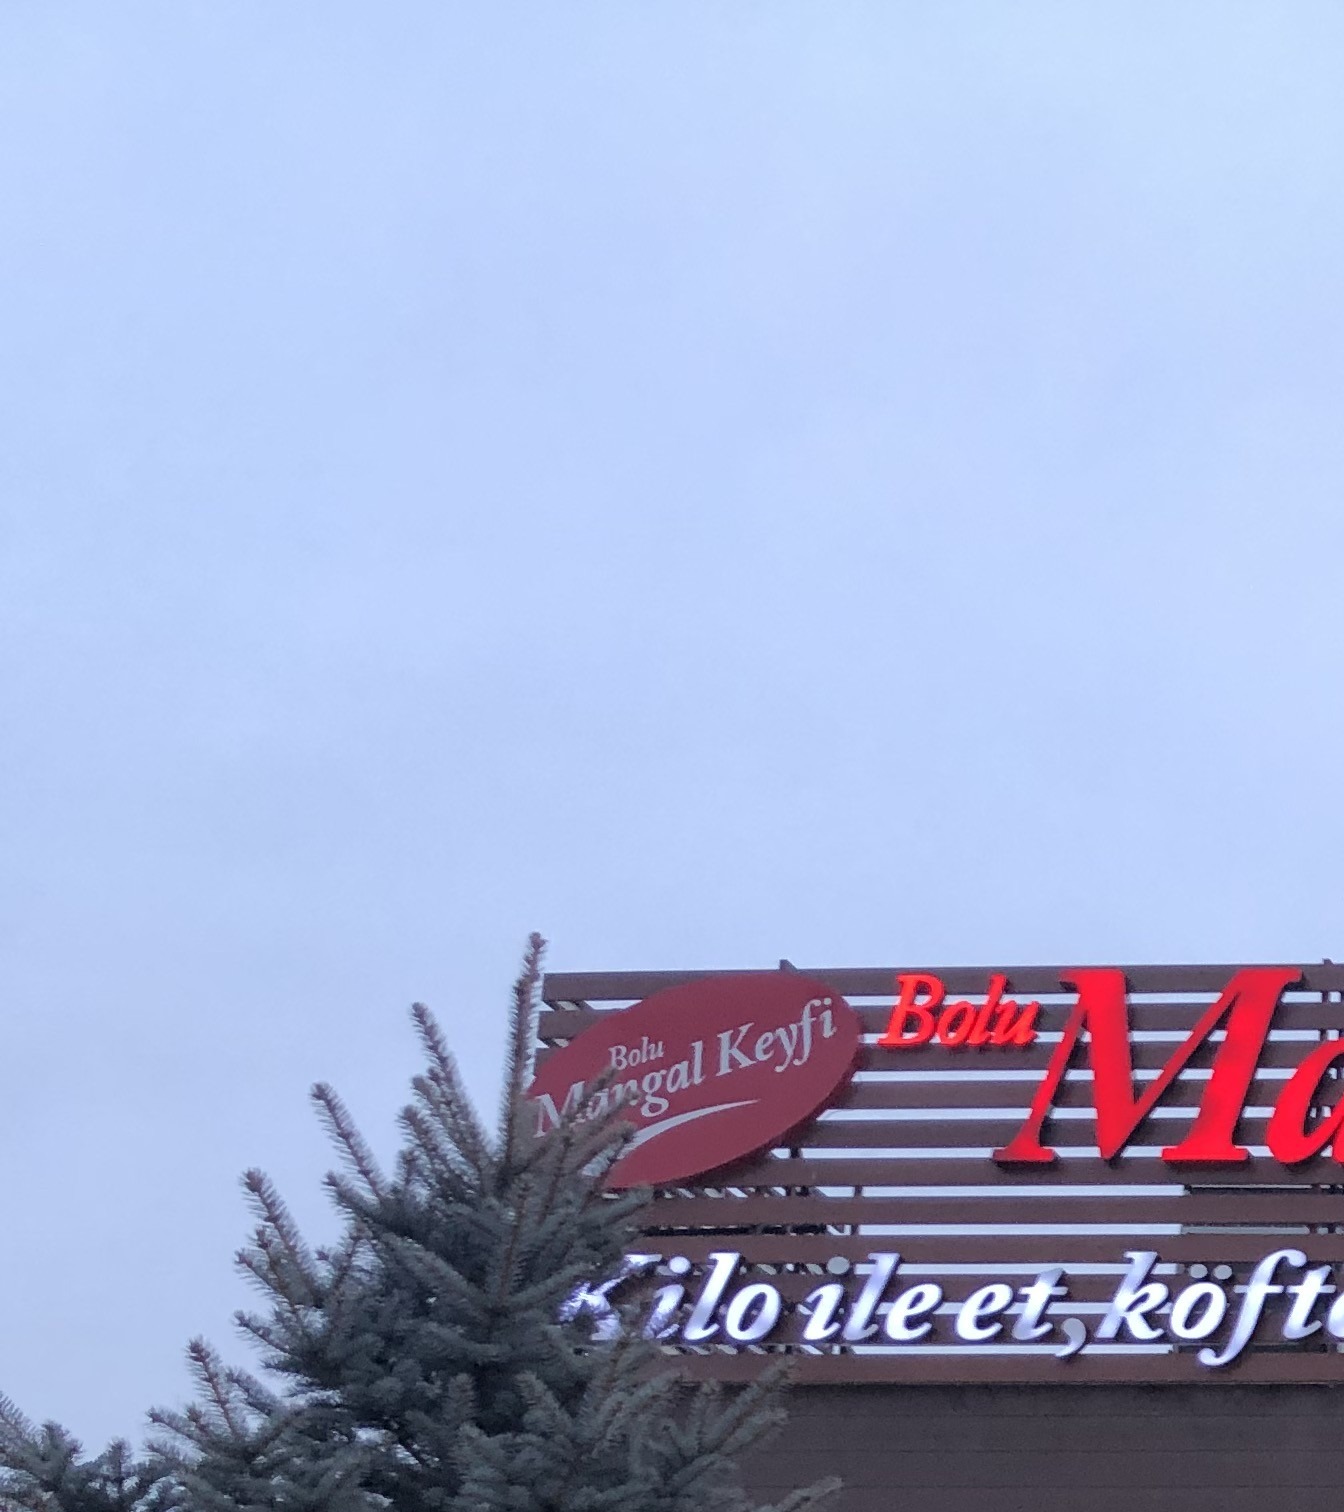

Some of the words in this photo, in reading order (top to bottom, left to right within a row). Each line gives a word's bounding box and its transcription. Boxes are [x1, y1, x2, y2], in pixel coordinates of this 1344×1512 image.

[608, 1035, 665, 1071] Bolu
[878, 973, 1041, 1050] Bolu
[533, 1040, 706, 1138] Mangal
[716, 997, 838, 1077] Keyfi
[802, 1252, 949, 1342] ile
